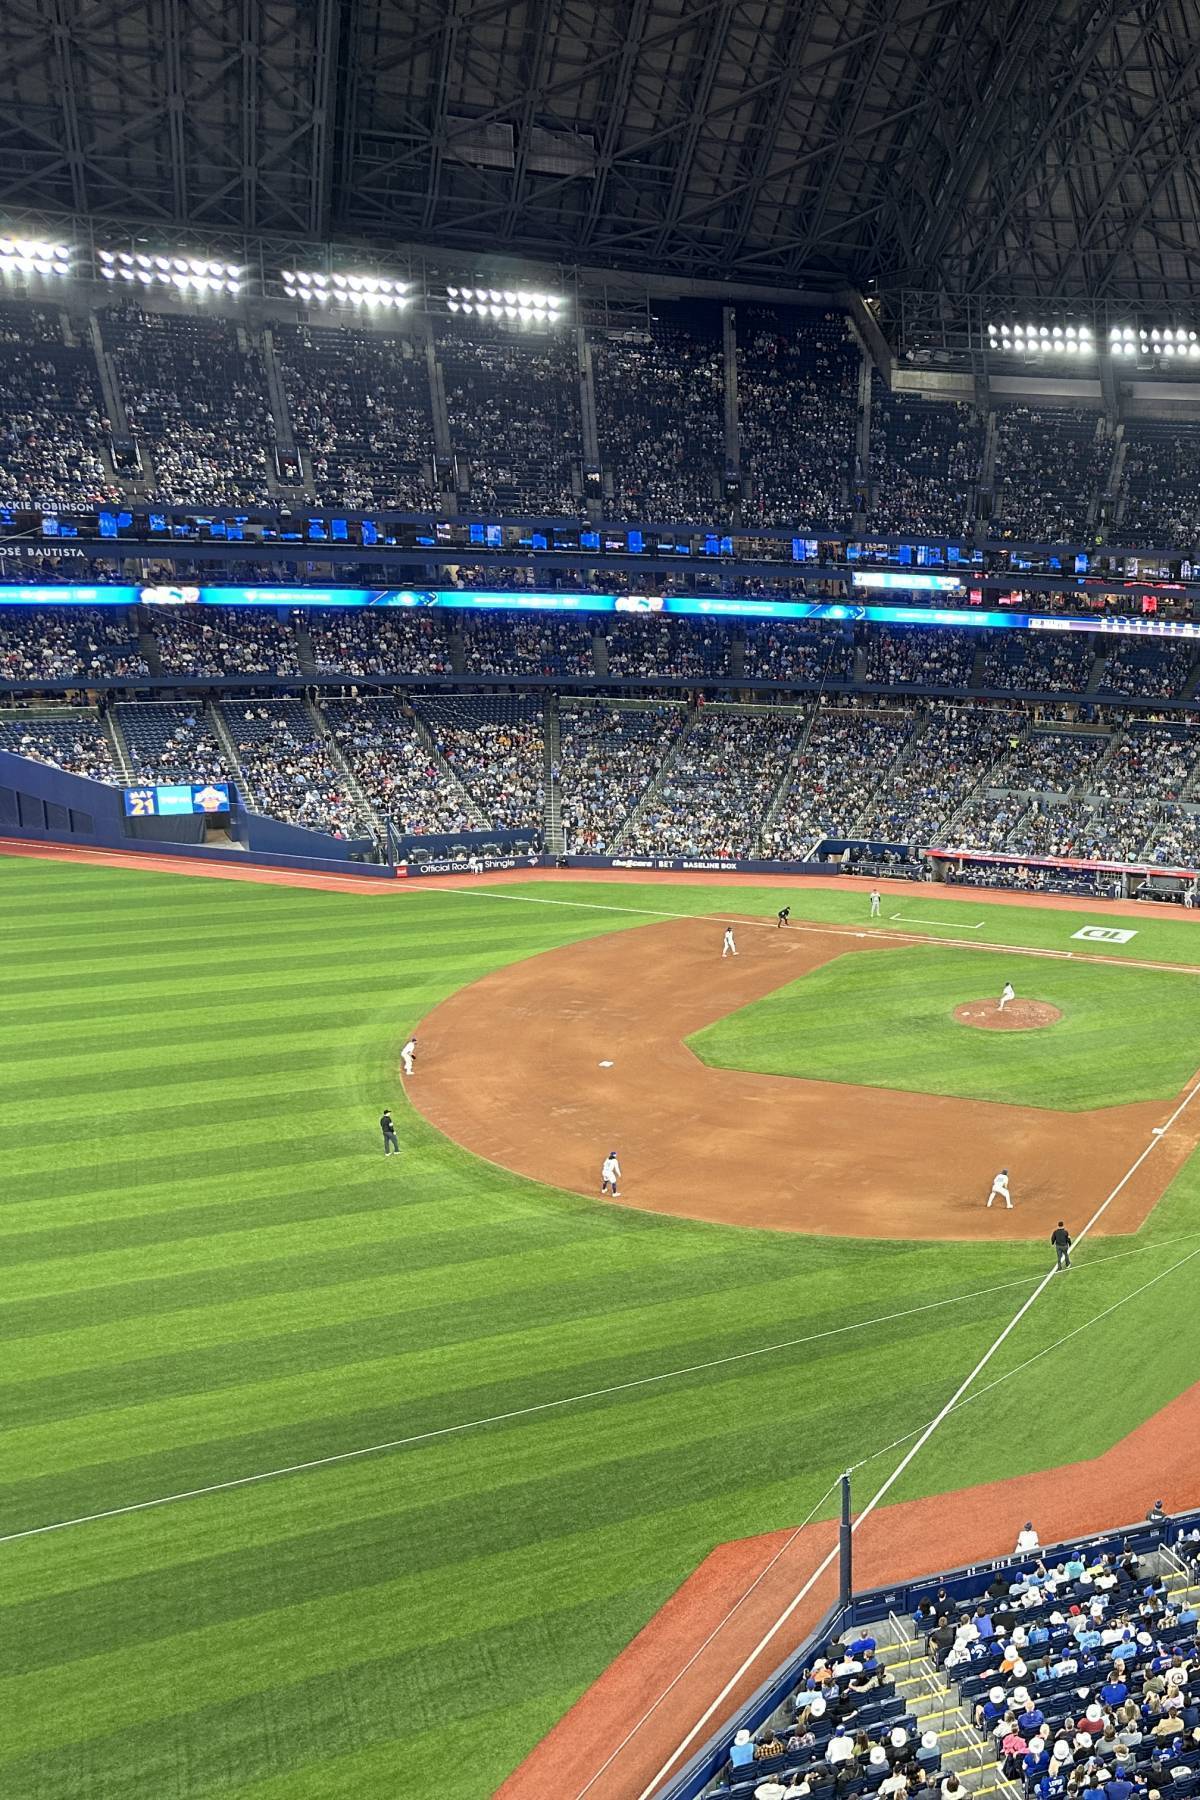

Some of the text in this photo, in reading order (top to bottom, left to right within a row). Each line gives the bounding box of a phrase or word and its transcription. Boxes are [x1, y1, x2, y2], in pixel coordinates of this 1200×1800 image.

[35, 502, 94, 512] ROBINSON
[28, 548, 85, 557] BAUTISTA
[131, 799, 155, 815] 21
[420, 863, 450, 874] Official
[484, 859, 515, 869] Shingle
[658, 860, 673, 868] BET
[683, 861, 719, 869] BASELINE
[721, 862, 737, 870] BOX
